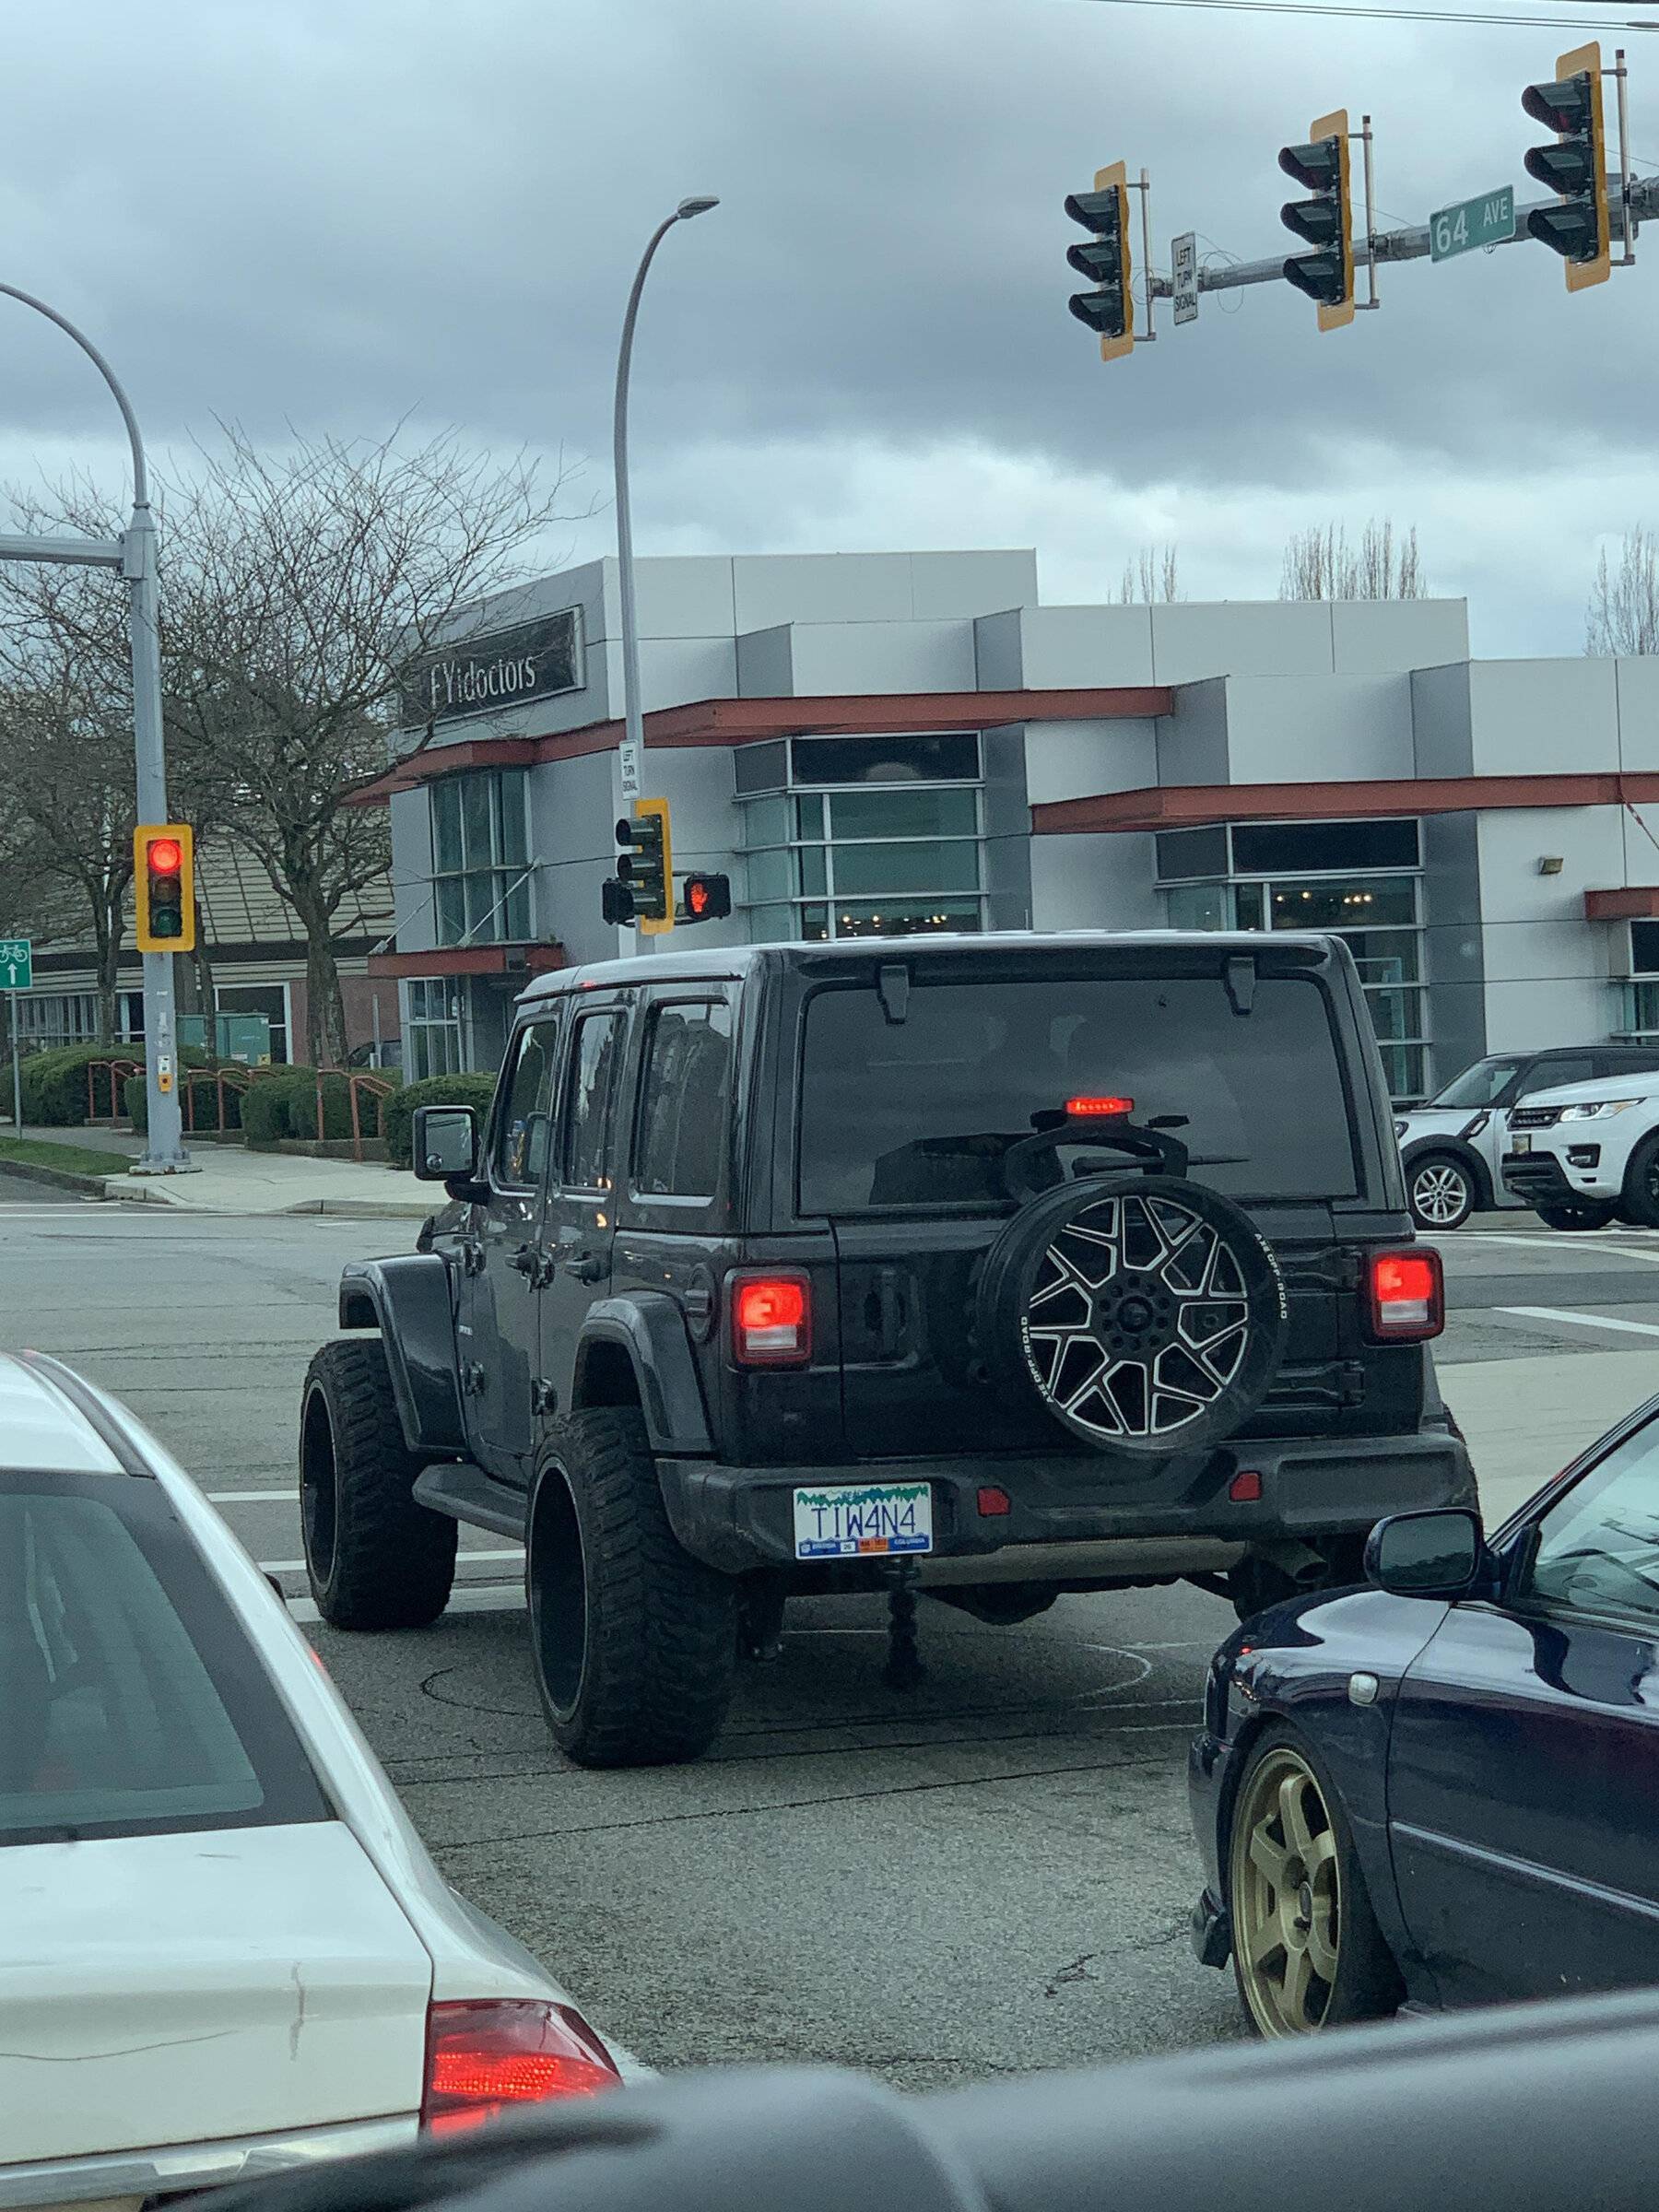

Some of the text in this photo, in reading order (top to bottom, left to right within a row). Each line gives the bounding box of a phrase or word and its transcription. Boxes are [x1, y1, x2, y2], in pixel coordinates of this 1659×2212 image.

[1436, 196, 1509, 253] 64 AVE
[1176, 245, 1192, 266] LEFT
[1175, 291, 1196, 312] SIGNAL
[430, 655, 535, 709] FYidoctors
[810, 1502, 916, 1539] TIW4N4
